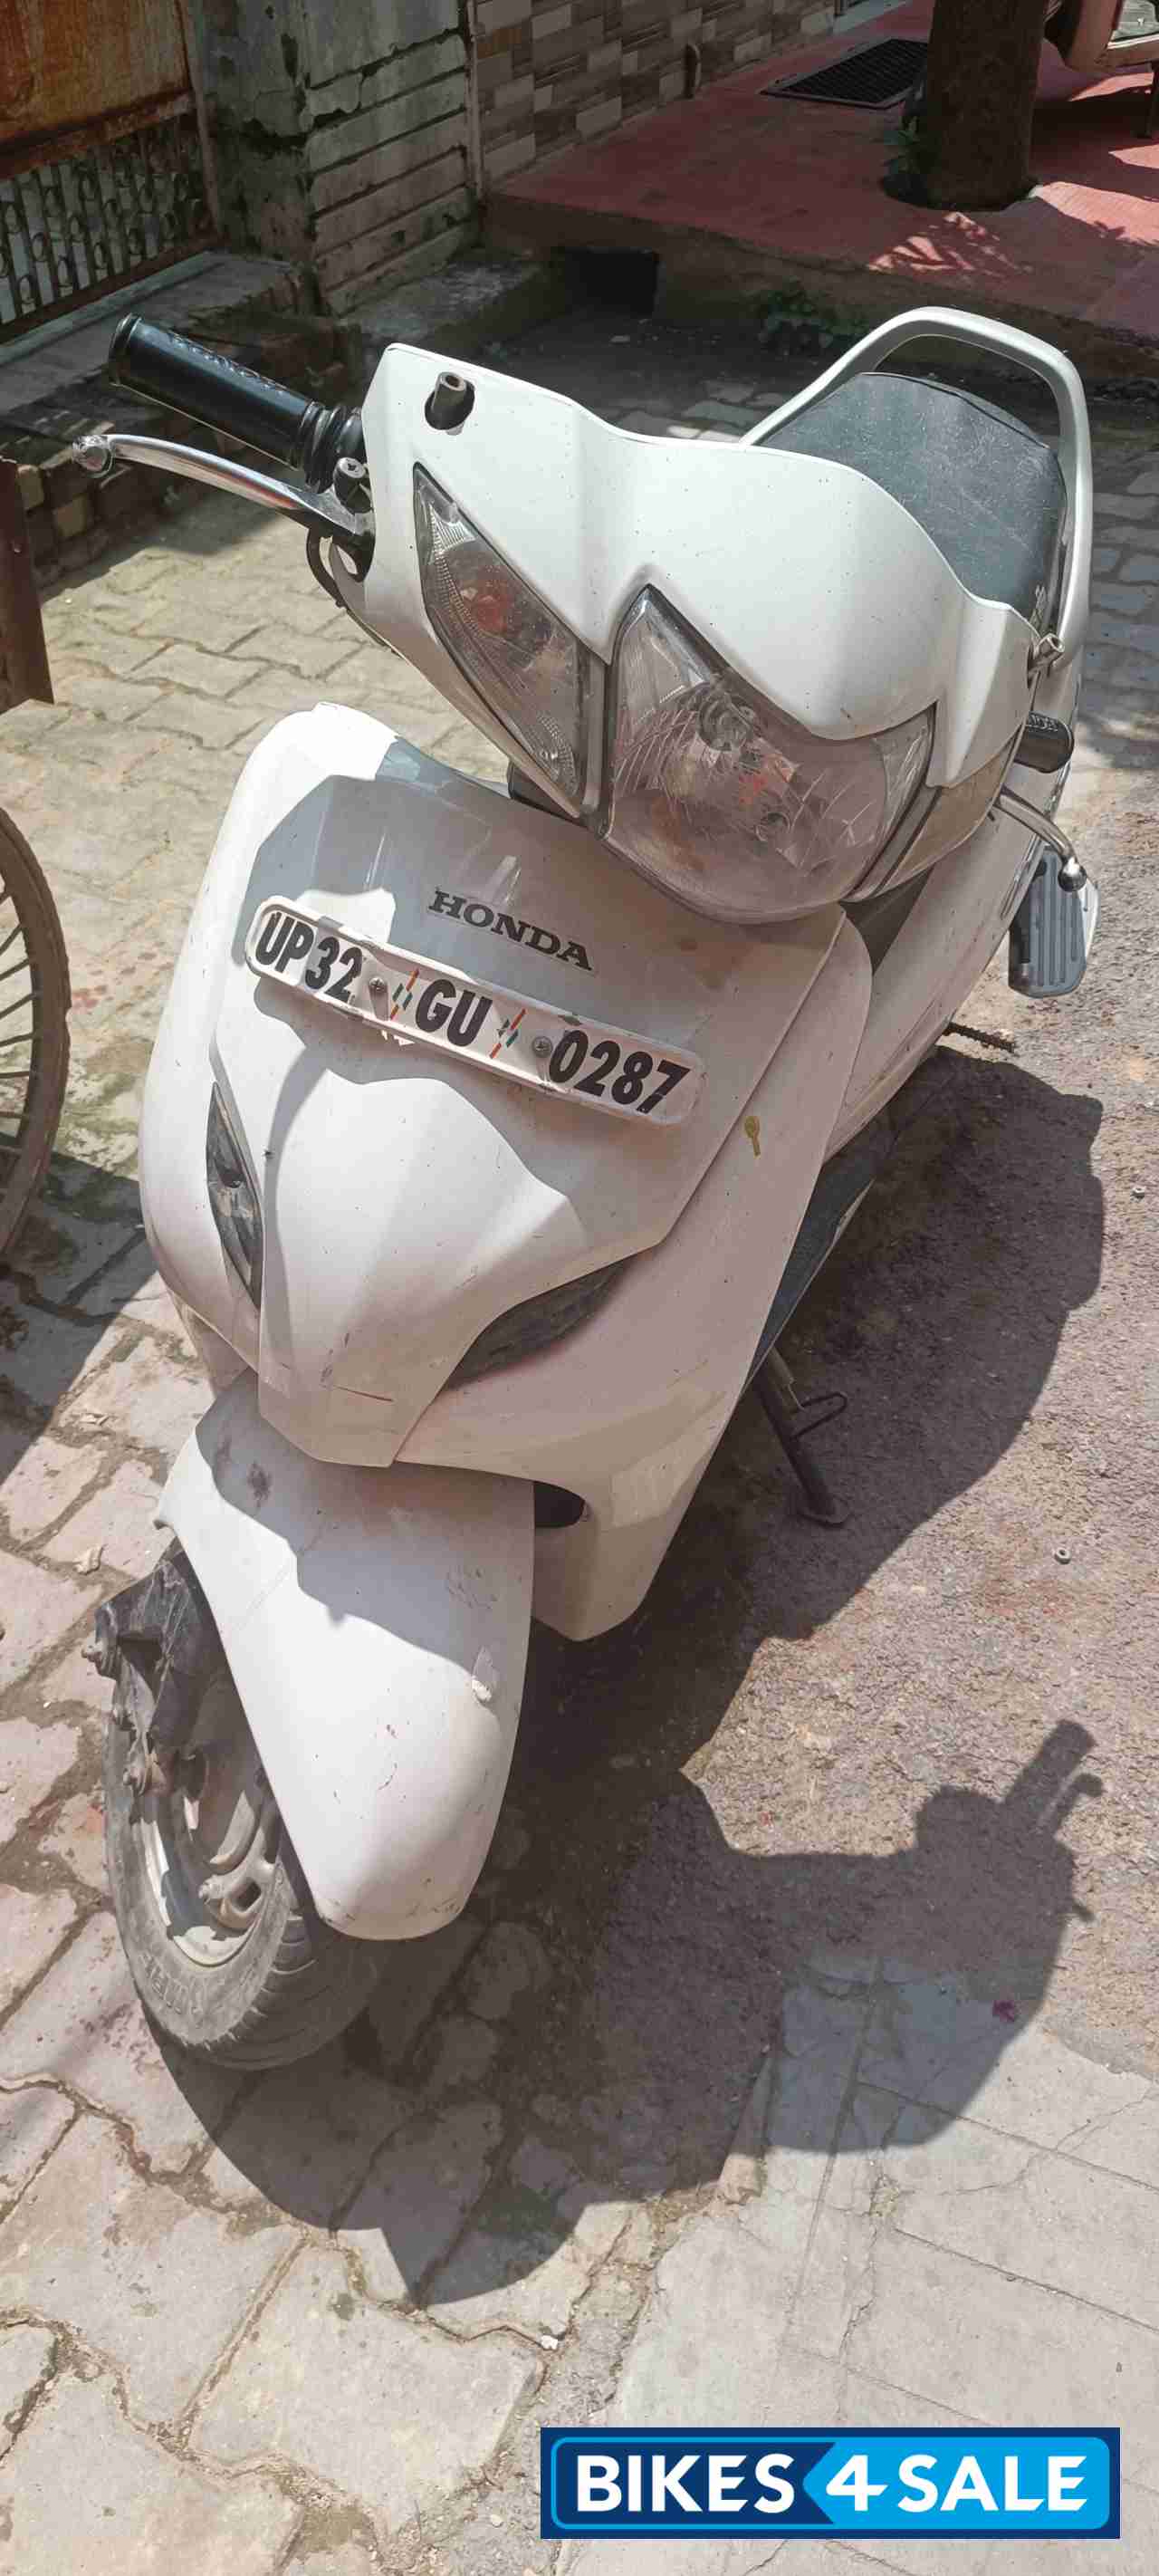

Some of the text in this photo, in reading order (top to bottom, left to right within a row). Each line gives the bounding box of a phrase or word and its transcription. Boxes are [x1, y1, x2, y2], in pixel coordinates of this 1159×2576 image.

[428, 890, 592, 971] HONDA
[415, 979, 493, 1046] GU
[549, 1030, 690, 1114] 0287
